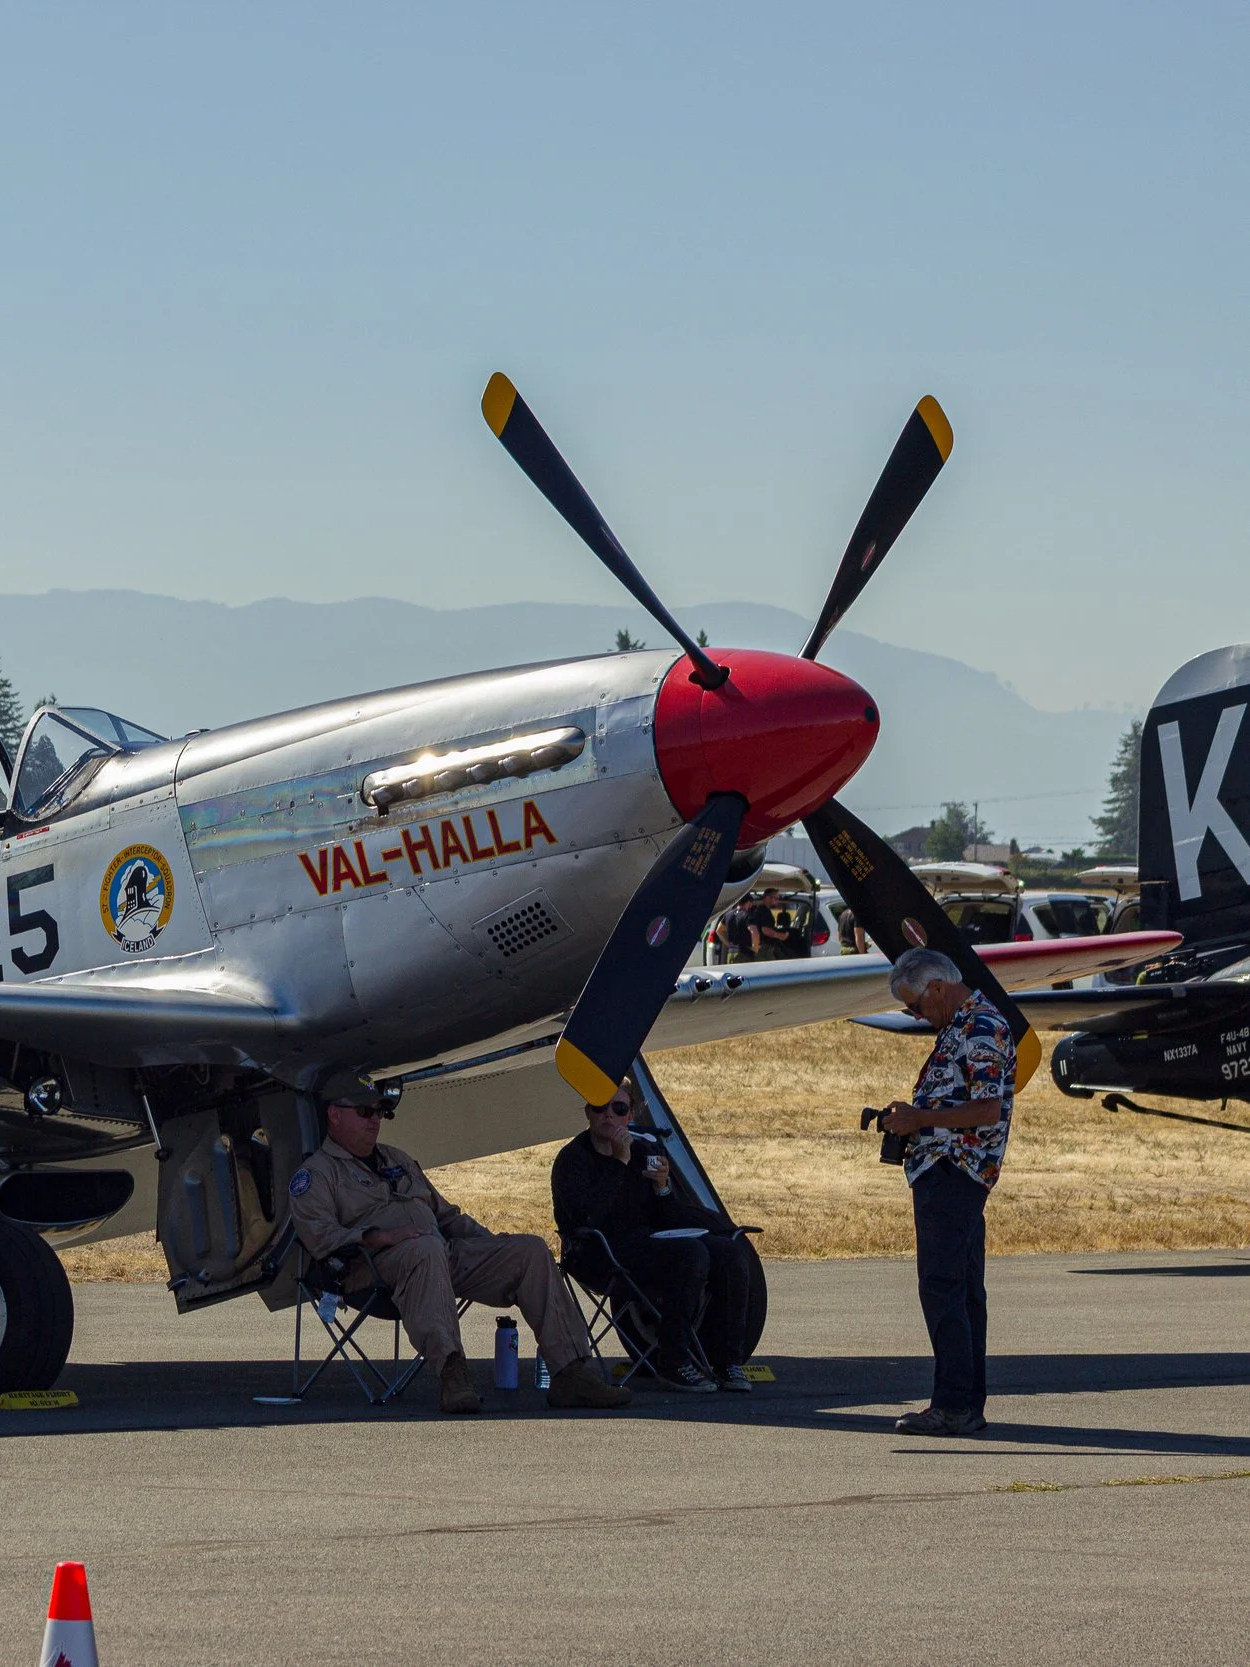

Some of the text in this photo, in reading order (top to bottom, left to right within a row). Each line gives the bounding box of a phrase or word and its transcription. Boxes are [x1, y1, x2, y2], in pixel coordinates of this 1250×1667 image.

[1157, 703, 1250, 902] K
[297, 800, 559, 897] VAL-HALLA
[120, 937, 155, 953] ICELAND
[1163, 1043, 1199, 1062] NX1337A
[1226, 1041, 1248, 1057] NAVY
